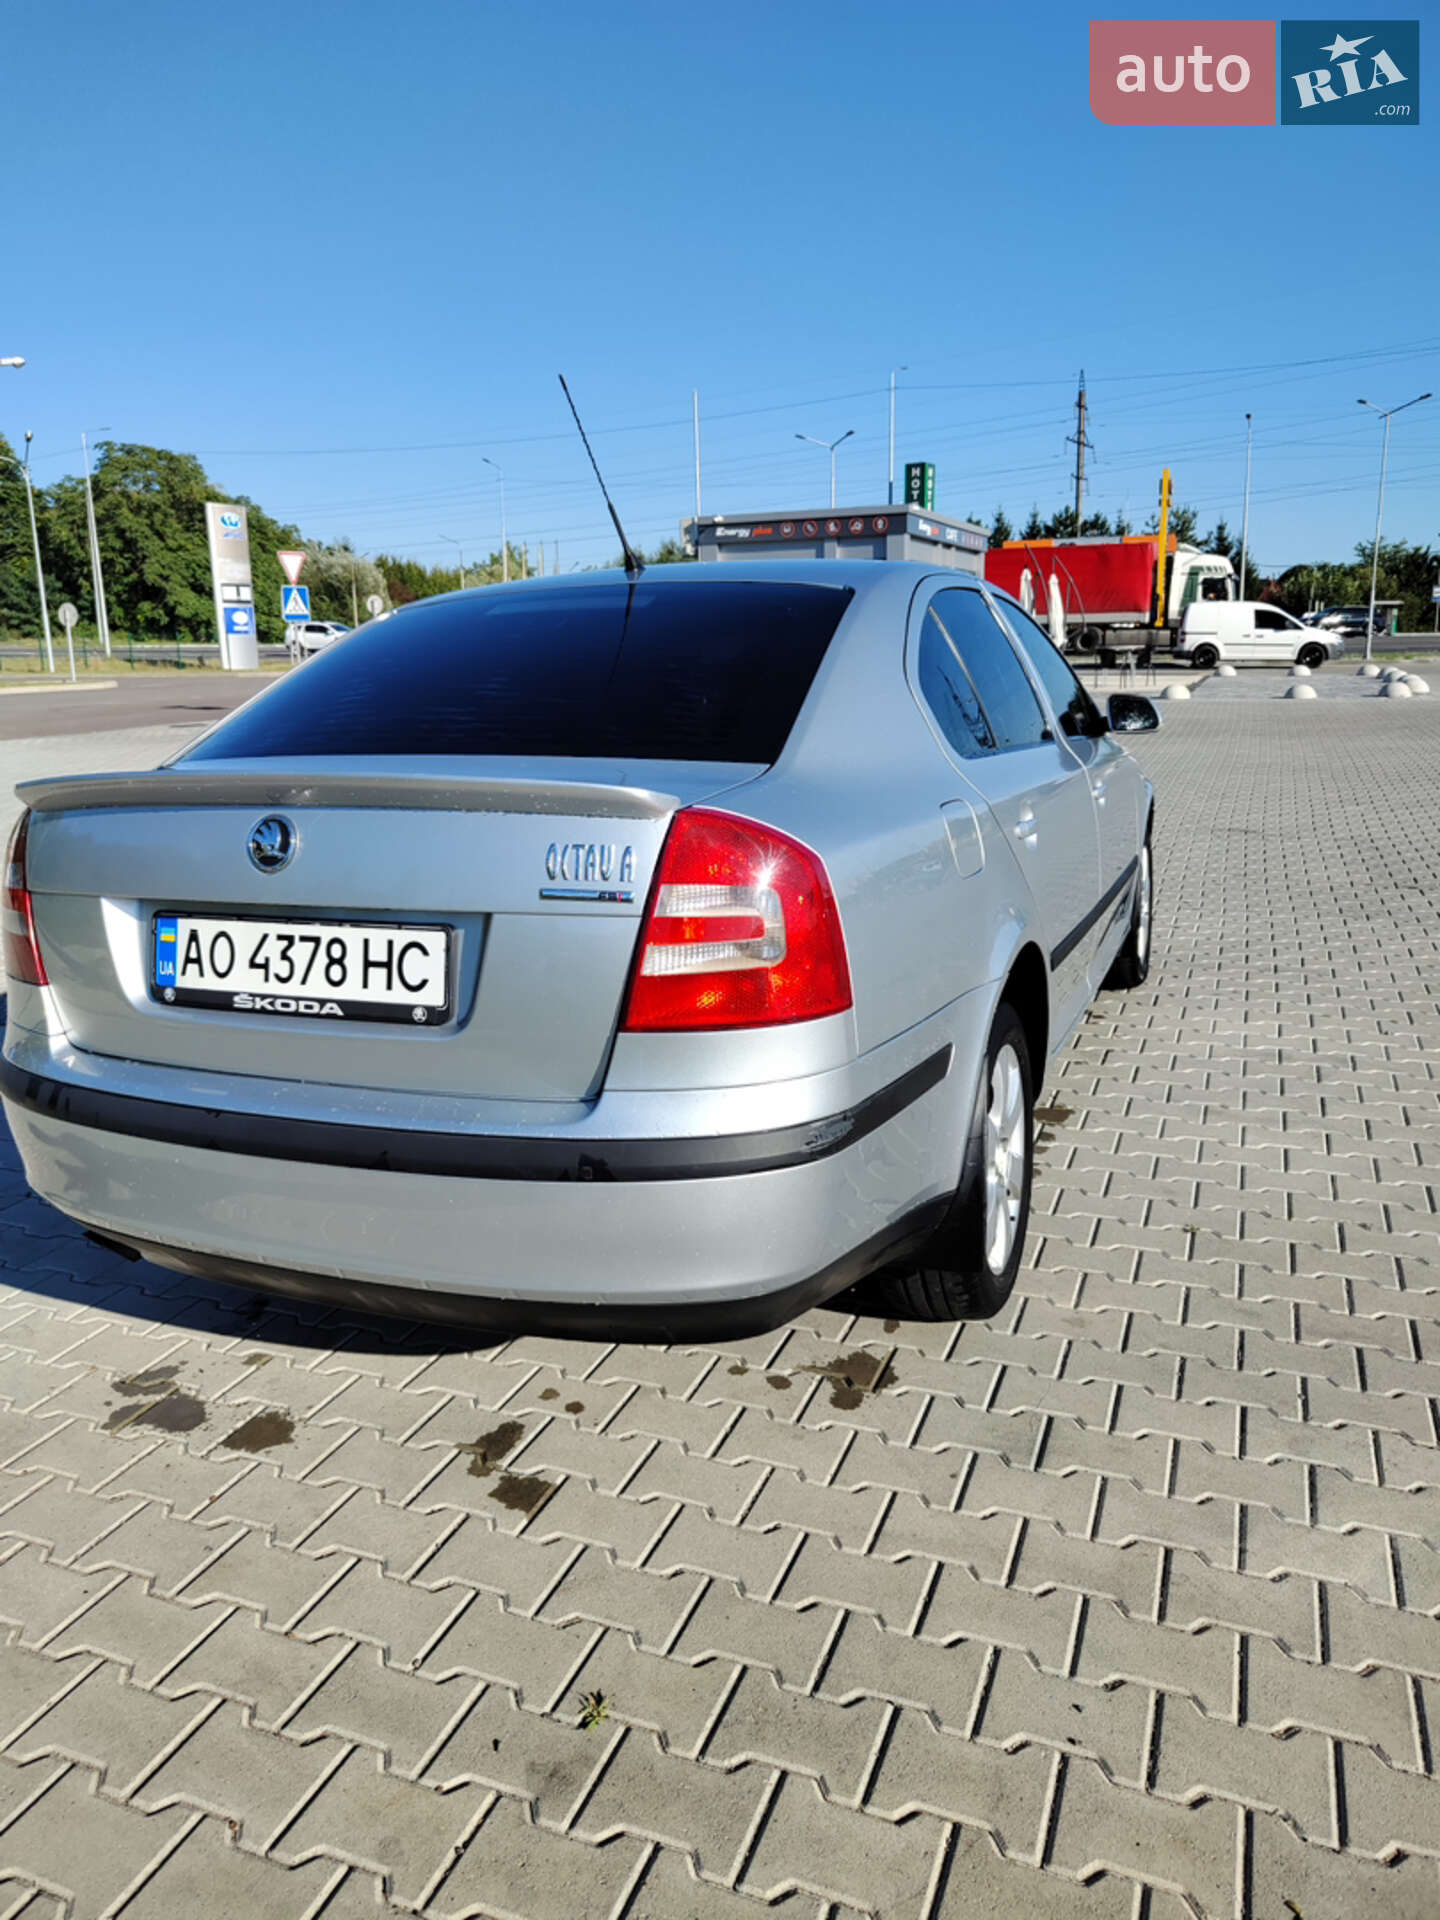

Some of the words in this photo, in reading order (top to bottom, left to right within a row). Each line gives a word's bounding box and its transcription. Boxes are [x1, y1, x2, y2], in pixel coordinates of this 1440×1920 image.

[911, 466, 921, 504] HOT
[159, 960, 175, 976] UA
[180, 928, 236, 980] AO
[248, 932, 348, 988] 4378
[361, 937, 431, 993] HC
[232, 993, 345, 1017] ŠKODA
